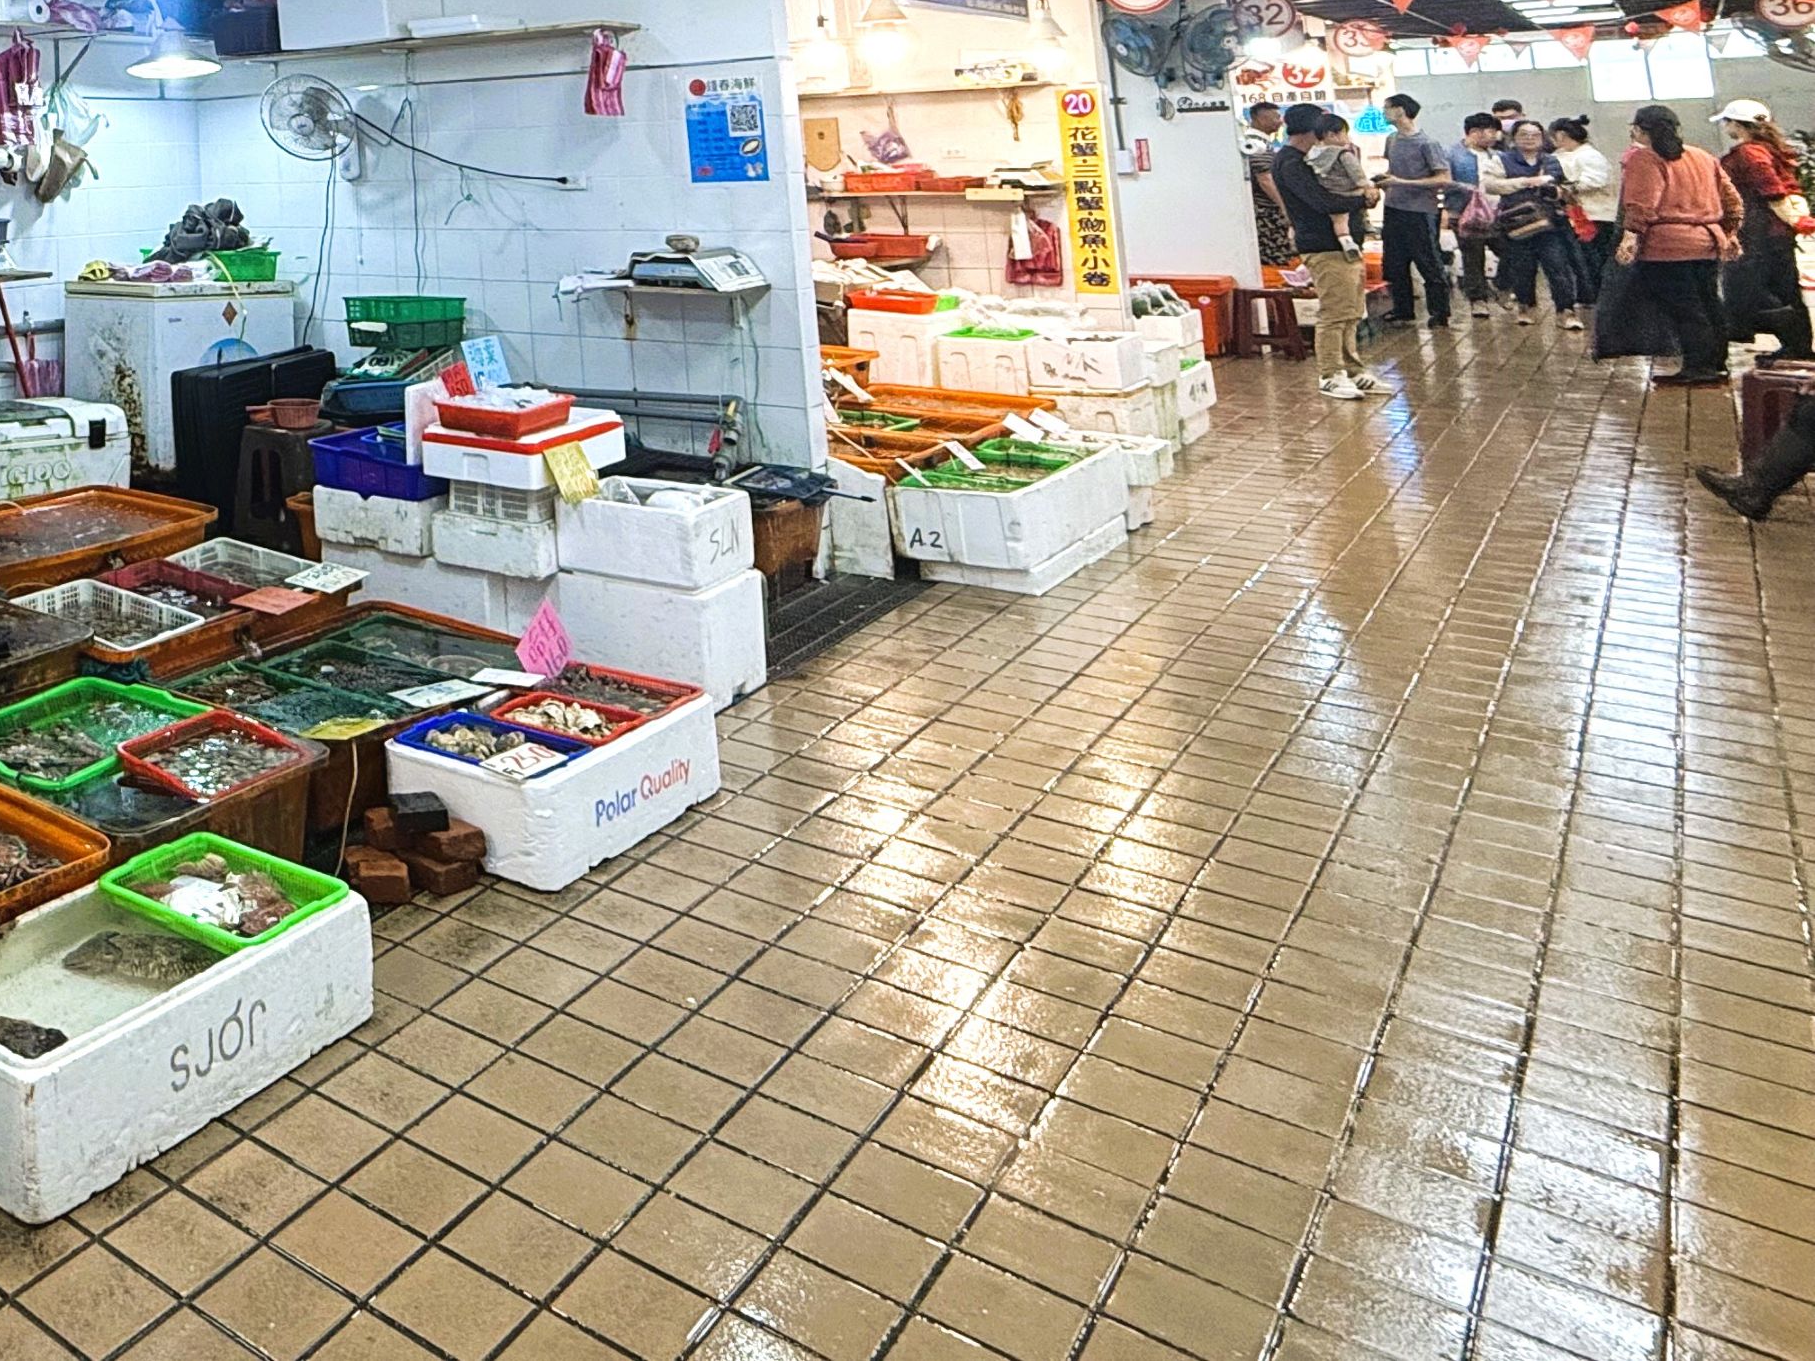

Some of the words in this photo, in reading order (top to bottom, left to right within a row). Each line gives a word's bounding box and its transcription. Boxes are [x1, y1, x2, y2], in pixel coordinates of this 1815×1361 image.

[1064, 93, 1092, 115] 20
[500, 746, 557, 770] 250
[595, 788, 638, 827] Polar
[640, 759, 691, 801] Quality
